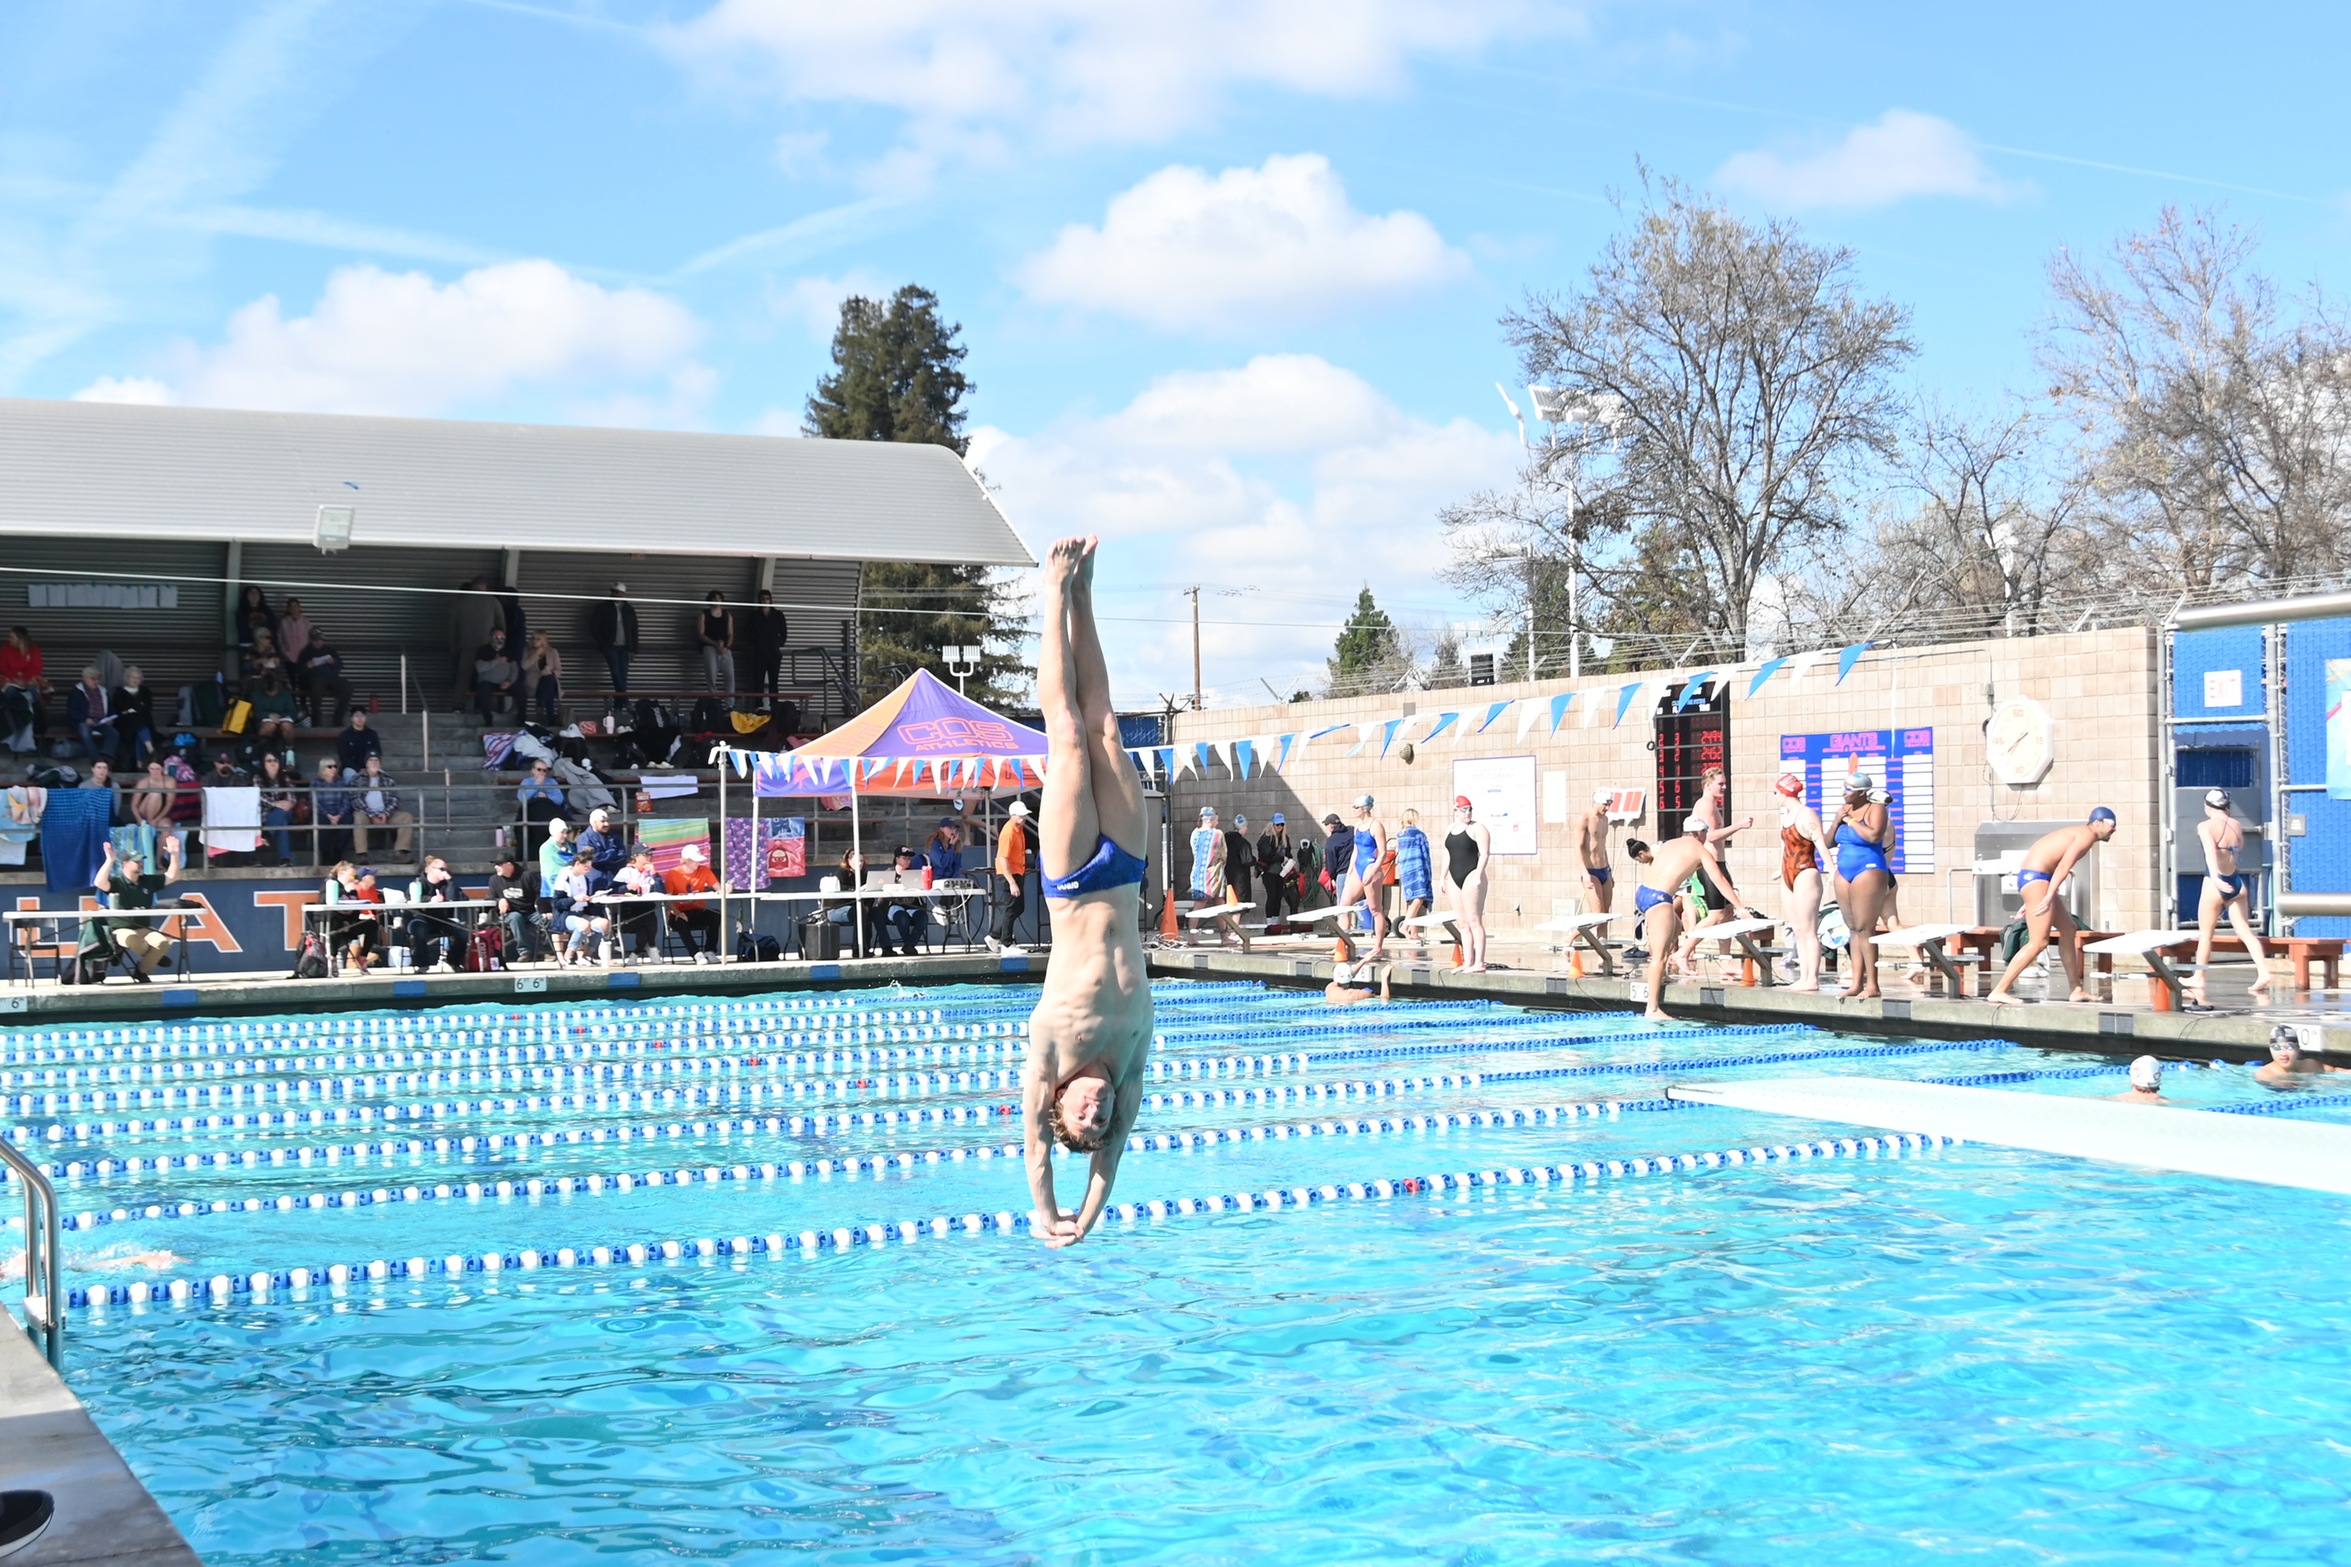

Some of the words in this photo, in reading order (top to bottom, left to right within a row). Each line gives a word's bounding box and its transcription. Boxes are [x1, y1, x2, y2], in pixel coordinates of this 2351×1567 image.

[897, 716, 1014, 745] COS
[915, 738, 1019, 752] ATHLETICS
[1830, 732, 1878, 749] GIANTS
